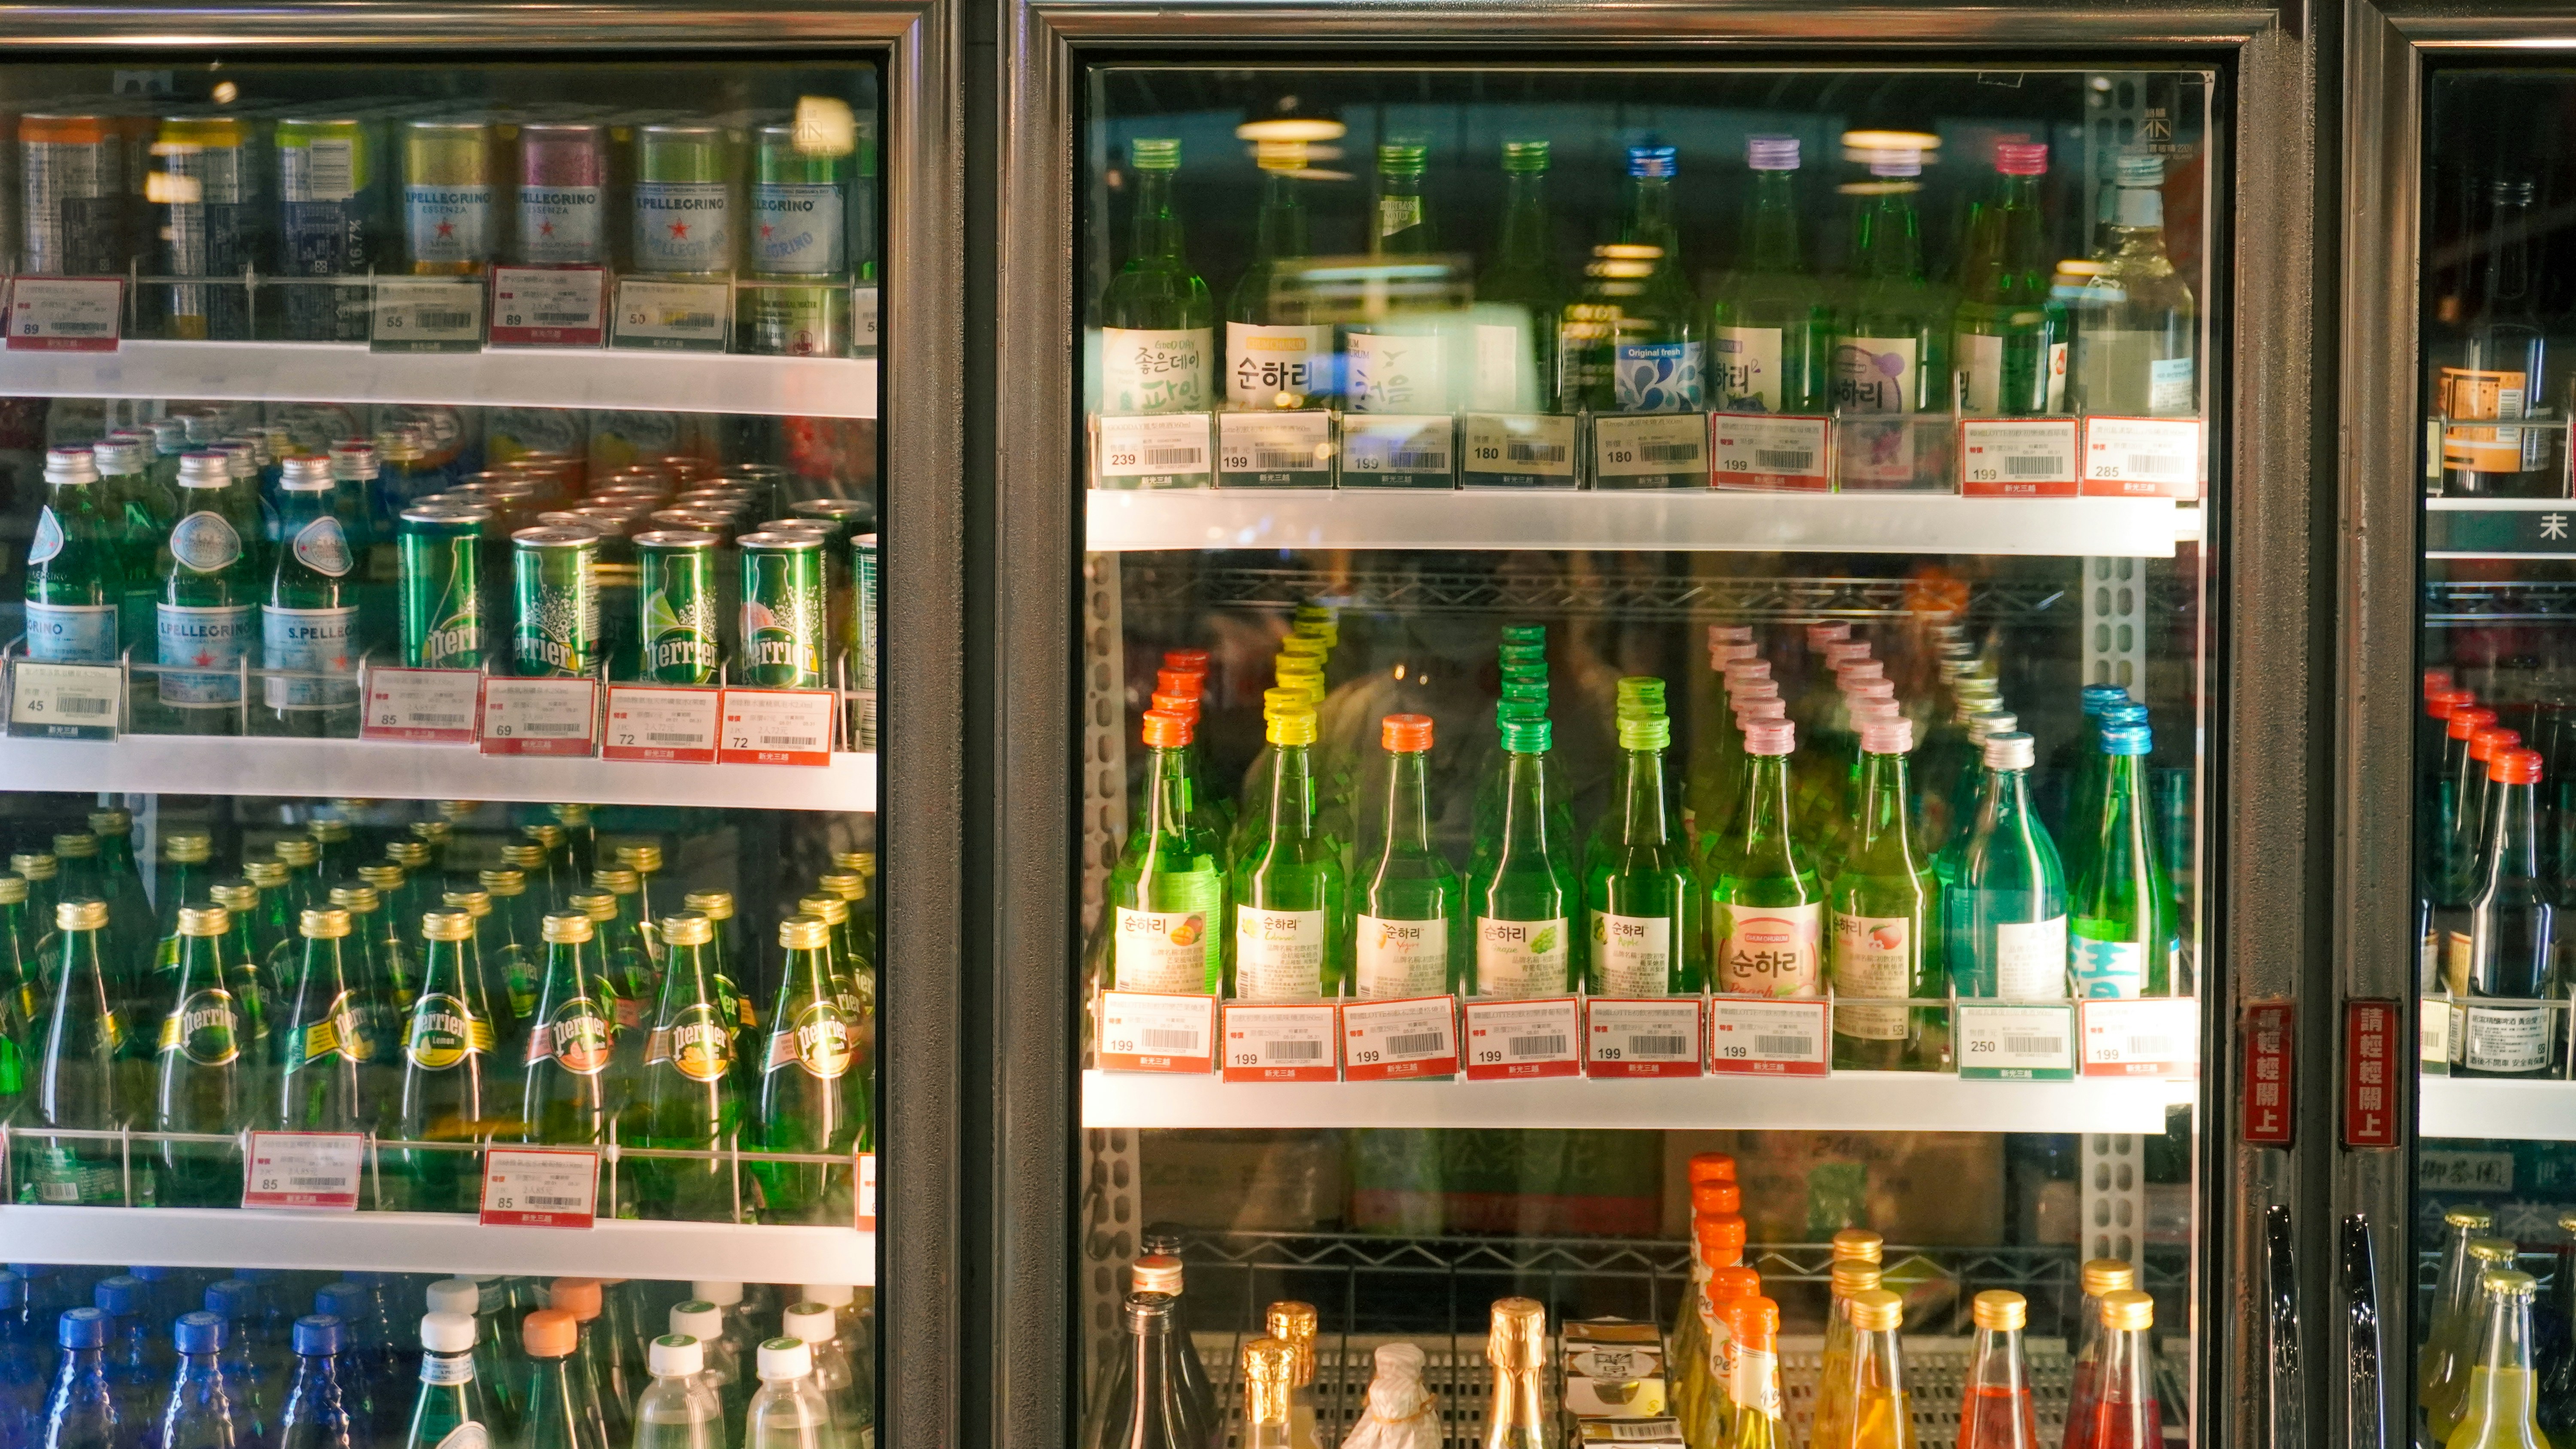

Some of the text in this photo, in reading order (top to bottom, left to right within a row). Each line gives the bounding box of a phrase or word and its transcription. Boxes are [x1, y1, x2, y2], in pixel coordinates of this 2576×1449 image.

[349, 219, 362, 267] 16.7%
[386, 317, 403, 327] 55
[506, 314, 522, 325] 89
[629, 314, 646, 324] 50
[23, 323, 39, 334] 89
[1155, 339, 1195, 352] GOOD DAY
[1271, 339, 1305, 350] CHURUM
[1628, 348, 1659, 358] Original
[1661, 347, 1681, 356] fresh
[1134, 347, 1200, 375] 좋은데이
[1237, 357, 1313, 391] 순하리
[1474, 447, 1499, 459] 180
[1607, 451, 1632, 463] 180
[1112, 455, 1136, 465] 239
[1224, 457, 1247, 467] 199
[1355, 457, 1379, 470] 199
[1724, 459, 1747, 470] 199
[1974, 469, 1997, 480] 199
[2096, 466, 2119, 477] 285
[1141, 475, 1173, 484] 新光三越
[1382, 475, 1412, 483] 新光三越
[2124, 483, 2155, 491] 新光三越
[28, 700, 44, 711] 45
[381, 714, 397, 725] 85
[496, 725, 512, 736] 69
[619, 734, 635, 745] 72
[732, 737, 748, 748] 72
[644, 749, 674, 758] 新光三越
[758, 752, 789, 761] 新光三越
[1125, 915, 1166, 934] 순하리
[1263, 917, 1297, 931] 순하리
[1612, 922, 1644, 937] 순하리
[1386, 925, 1420, 940] 순하리
[1485, 926, 1526, 943] 순하리
[1618, 936, 1639, 947] Apple
[1491, 944, 1518, 954] Grape
[1731, 949, 1804, 979] 순하리
[432, 1036, 455, 1045] Lemon
[830, 1041, 845, 1051] Peach
[1111, 1040, 1133, 1051] 199
[1724, 1046, 1747, 1057] 199
[1971, 1041, 1996, 1052] 250
[1235, 1054, 1258, 1064] 199
[1356, 1051, 1379, 1063] 199
[1479, 1051, 1502, 1062] 199
[1598, 1048, 1621, 1059] 199
[2096, 1049, 2119, 1060] 199
[1140, 1057, 1170, 1065] 新光三越
[2470, 1056, 2545, 1067] 酒後不開車 安全有保障
[1387, 1064, 1417, 1073] 新光三越
[1509, 1065, 1539, 1073] 新光三越
[1753, 1063, 1785, 1071] 新光三越
[2126, 1064, 2157, 1072] 新光三越
[2255, 1009, 2281, 1132] 請輕輕關上
[2358, 1008, 2383, 1137] 請輕輕關上
[2001, 1070, 2032, 1078] 新光三越
[262, 1179, 278, 1190] 85
[498, 1197, 513, 1208] 85
